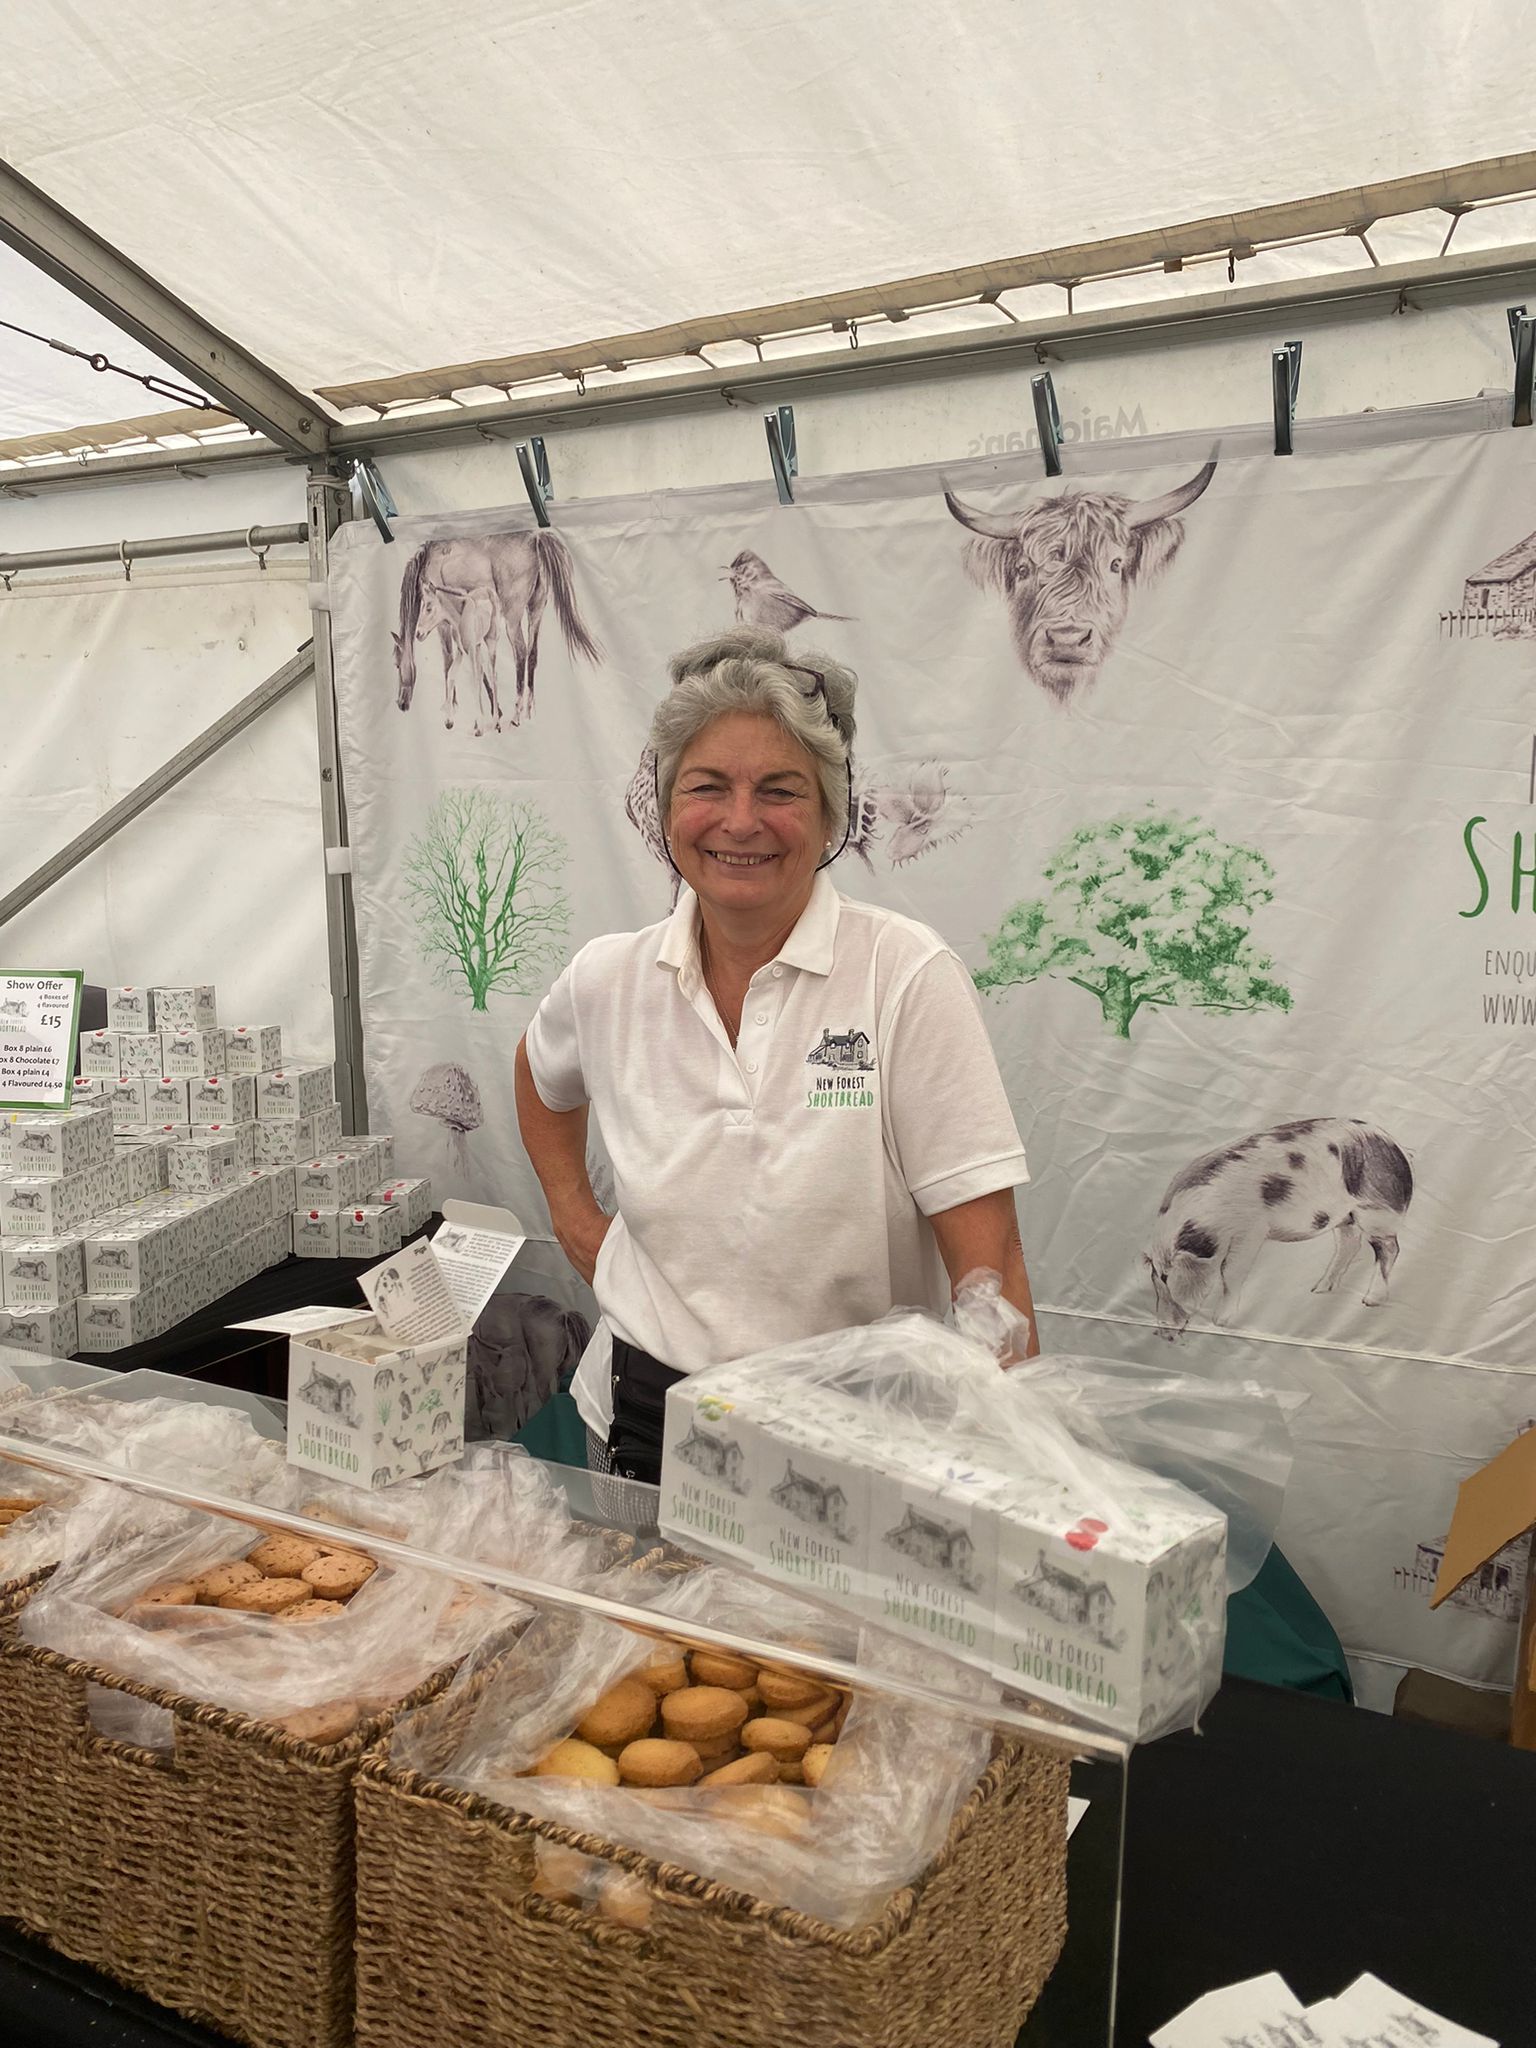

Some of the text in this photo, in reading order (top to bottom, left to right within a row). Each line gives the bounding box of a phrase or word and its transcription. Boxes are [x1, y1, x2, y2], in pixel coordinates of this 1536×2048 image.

[6, 980, 63, 990] Show Offer
[40, 1014, 62, 1029] £15
[25, 1045, 42, 1054] plain
[8, 1080, 43, 1088] Flavoured
[23, 1068, 40, 1077] plain
[41, 1069, 50, 1077] £4
[816, 1076, 865, 1090] NEW FOREST
[806, 1091, 874, 1108] SHORTBREAD
[306, 1421, 351, 1448] NEW FOREST
[298, 1434, 359, 1473] SHORTBREAD
[682, 1482, 737, 1516] NEW FOREST
[672, 1495, 745, 1545] SHORTBREAD
[780, 1527, 840, 1565] NEW FOREST
[769, 1541, 850, 1595] SHORTBREAD
[897, 1573, 965, 1615] NEW FOREST
[883, 1588, 976, 1648] SHORTBREAD
[1026, 1628, 1104, 1674] NEW FOREST
[1013, 1643, 1117, 1710] SHORTBREAD
